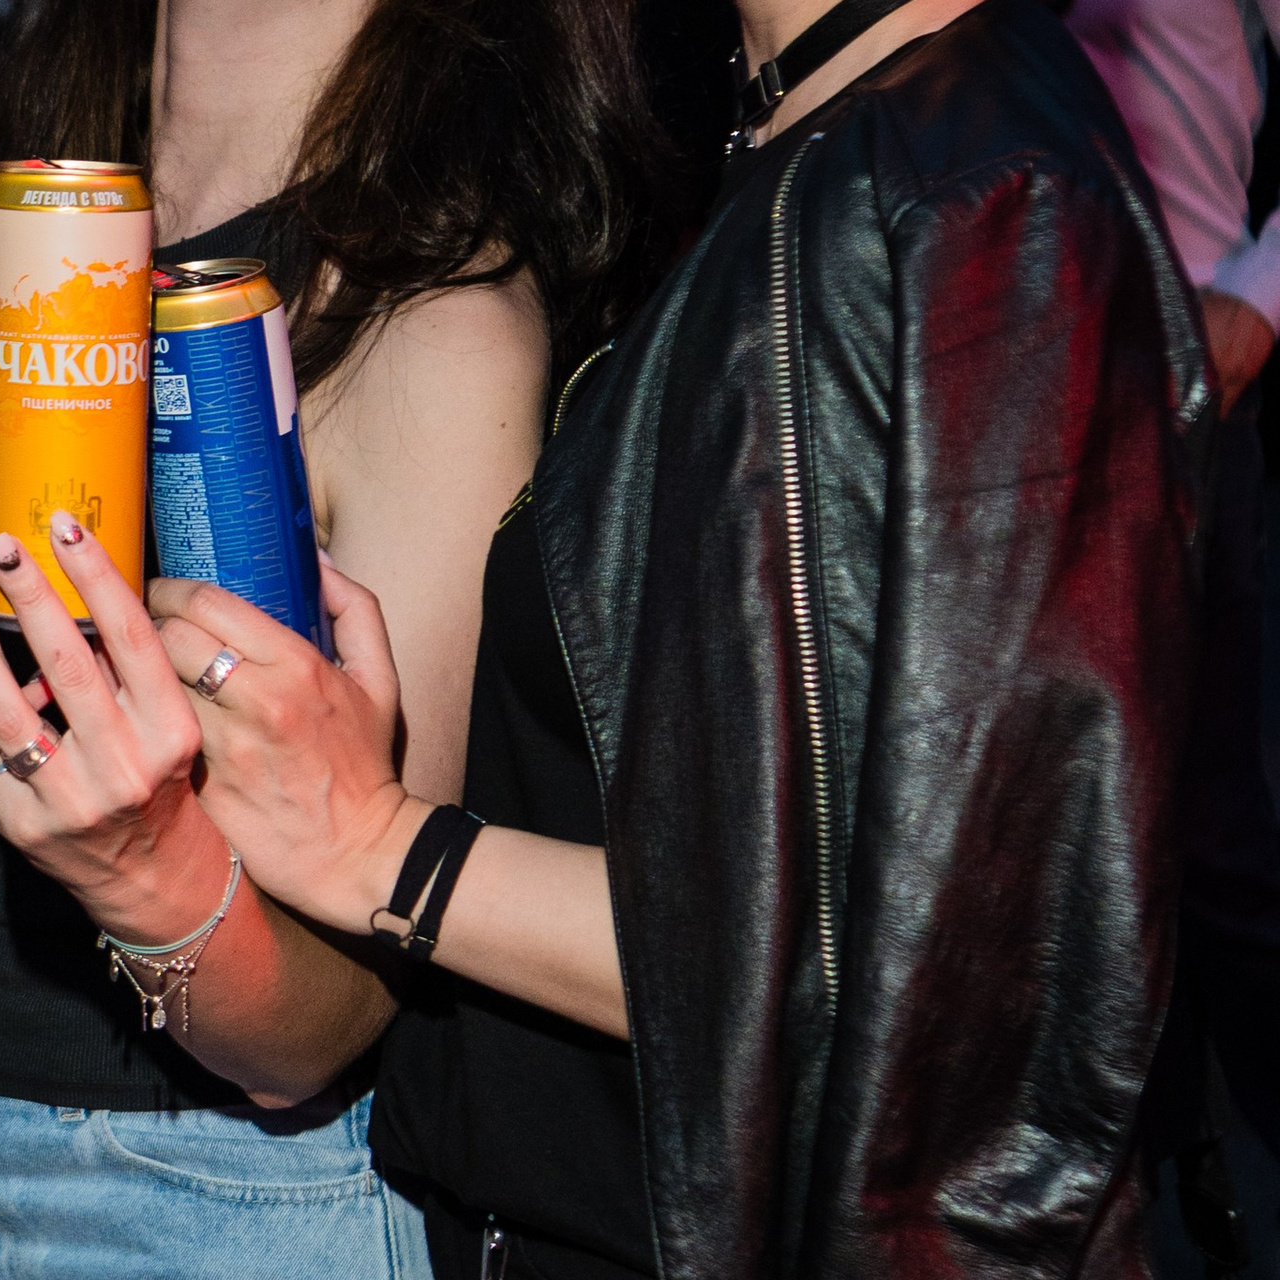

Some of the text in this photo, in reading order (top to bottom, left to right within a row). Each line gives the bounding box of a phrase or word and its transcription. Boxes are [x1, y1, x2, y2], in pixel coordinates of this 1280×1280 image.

[21, 189, 78, 206] ЛЕГЕНДА
[81, 191, 90, 206] С
[21, 396, 113, 411] ПШЕНИЧНОЕ
